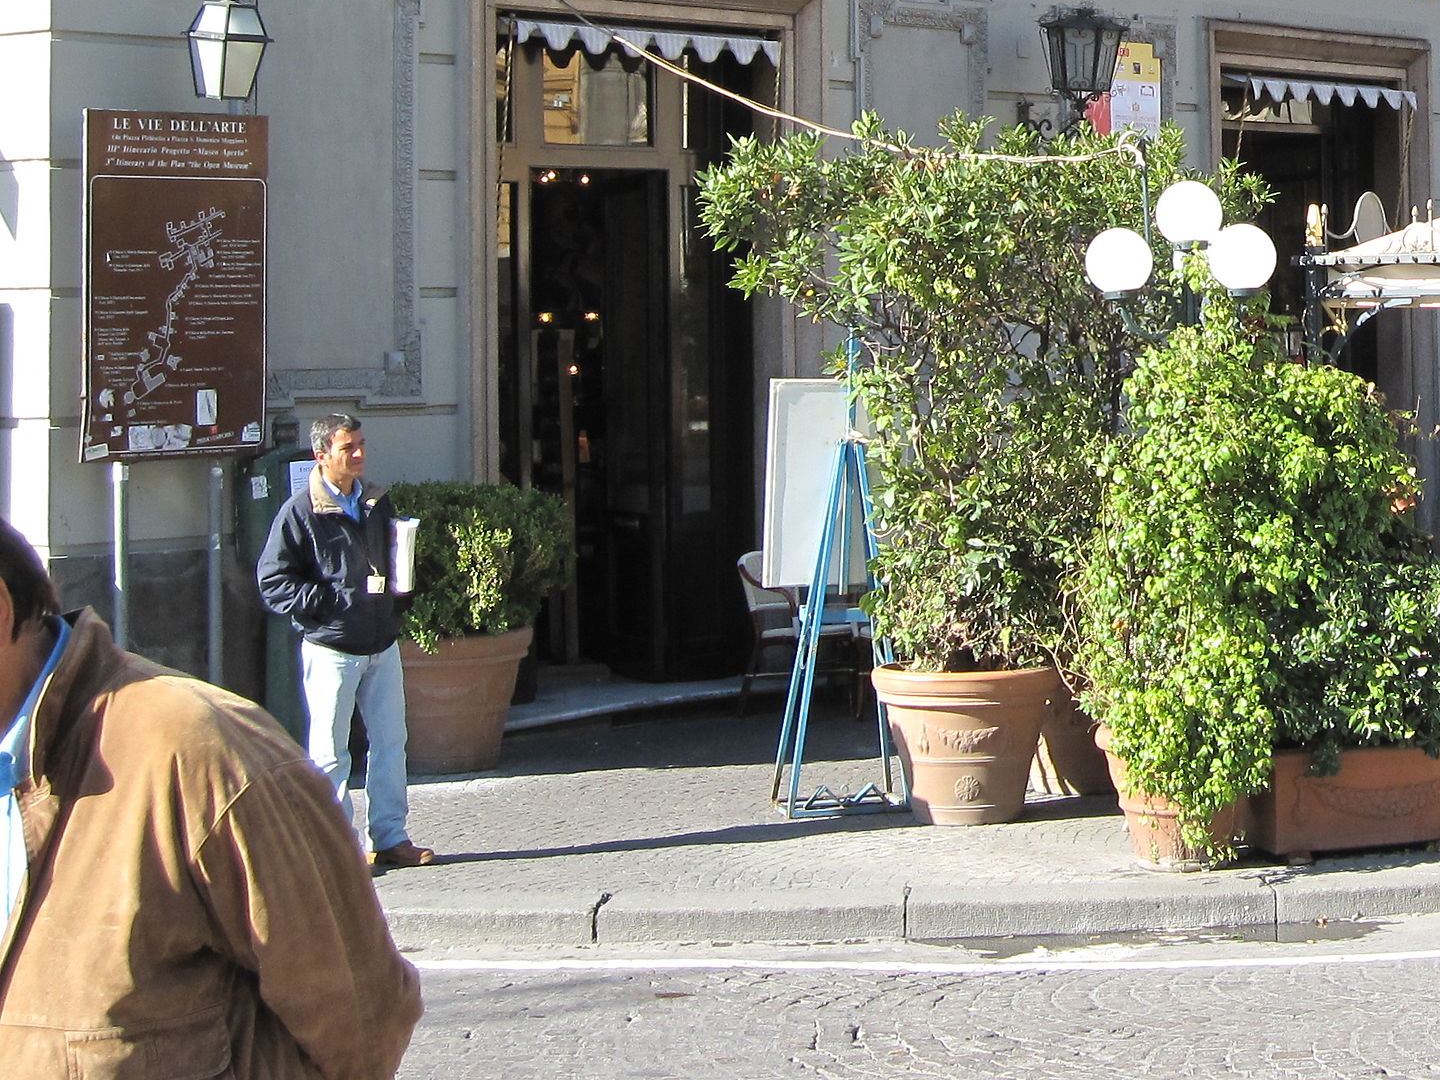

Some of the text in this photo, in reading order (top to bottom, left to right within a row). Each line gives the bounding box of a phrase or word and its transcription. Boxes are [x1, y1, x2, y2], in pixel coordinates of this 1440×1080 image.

[113, 117, 247, 133] LE VIE DELL'ARTE
[148, 159, 155, 167] of
[157, 159, 168, 167] the
